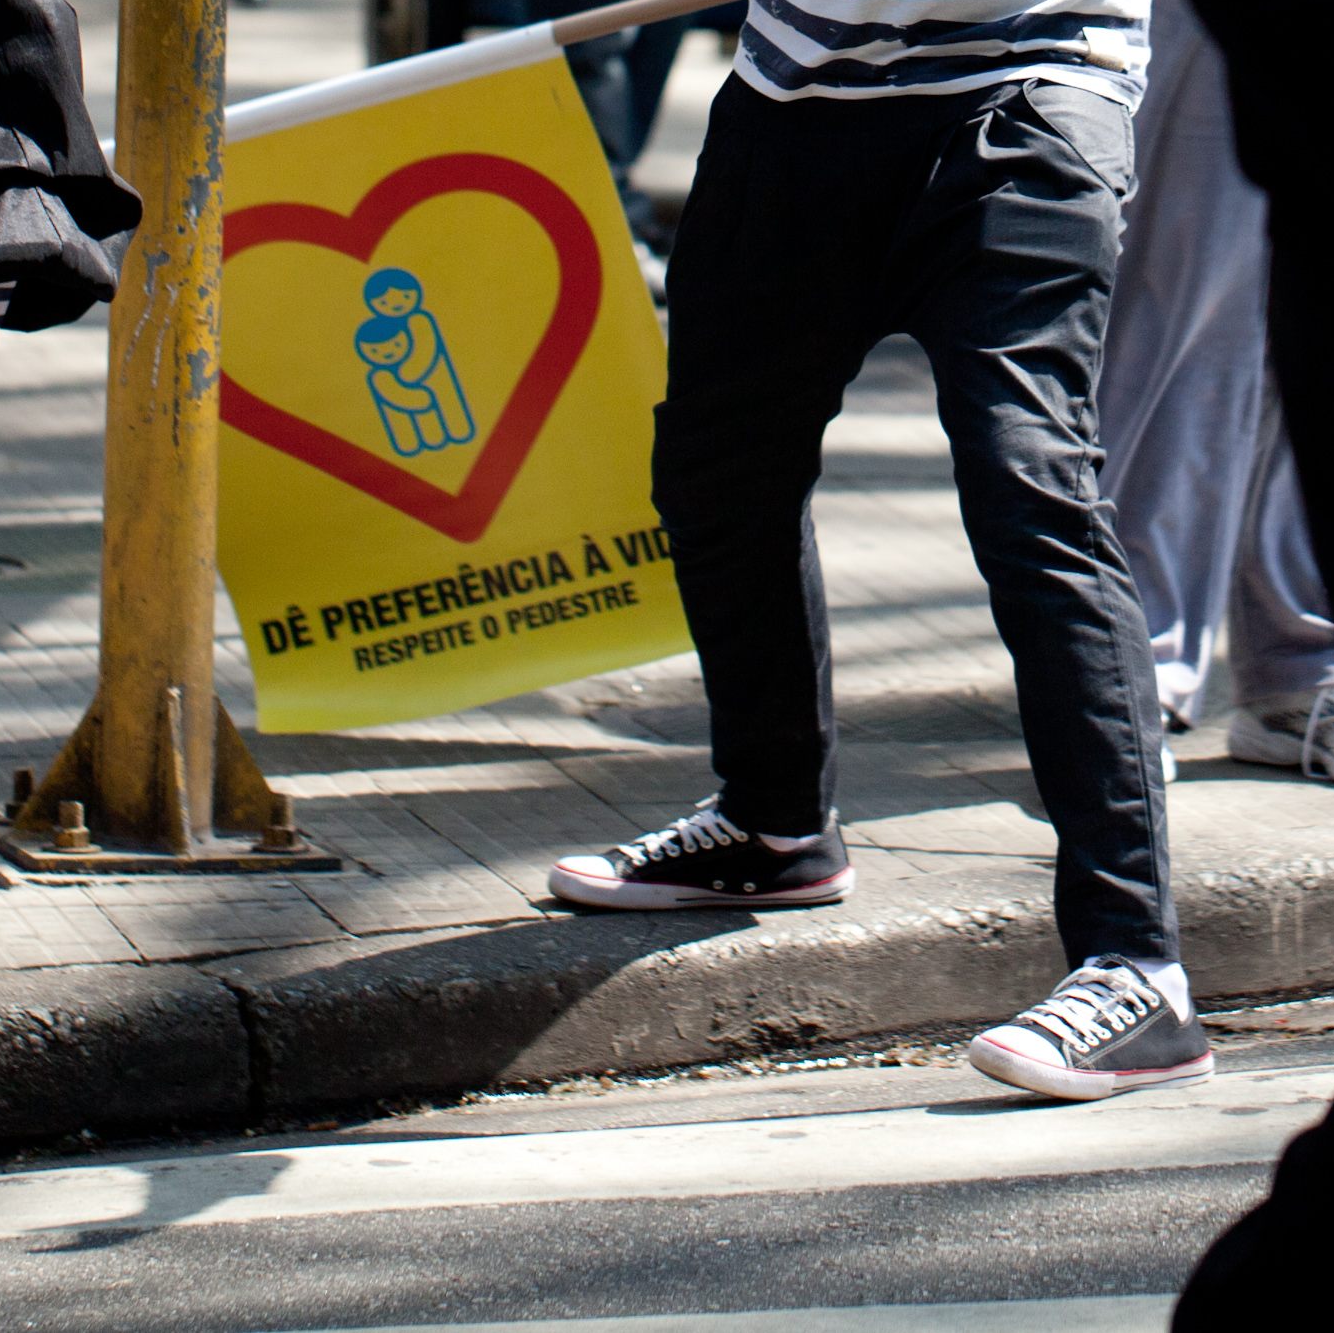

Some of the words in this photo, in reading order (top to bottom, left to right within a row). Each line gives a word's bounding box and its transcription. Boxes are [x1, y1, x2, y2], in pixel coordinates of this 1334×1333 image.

[261, 603, 315, 655] DÊ
[319, 550, 575, 641] PREFERÊNCIA
[581, 533, 612, 577] À
[613, 527, 671, 567] VID
[354, 621, 476, 672] RESPEITE
[482, 614, 500, 640] O
[505, 581, 640, 635] PEDESTRE
